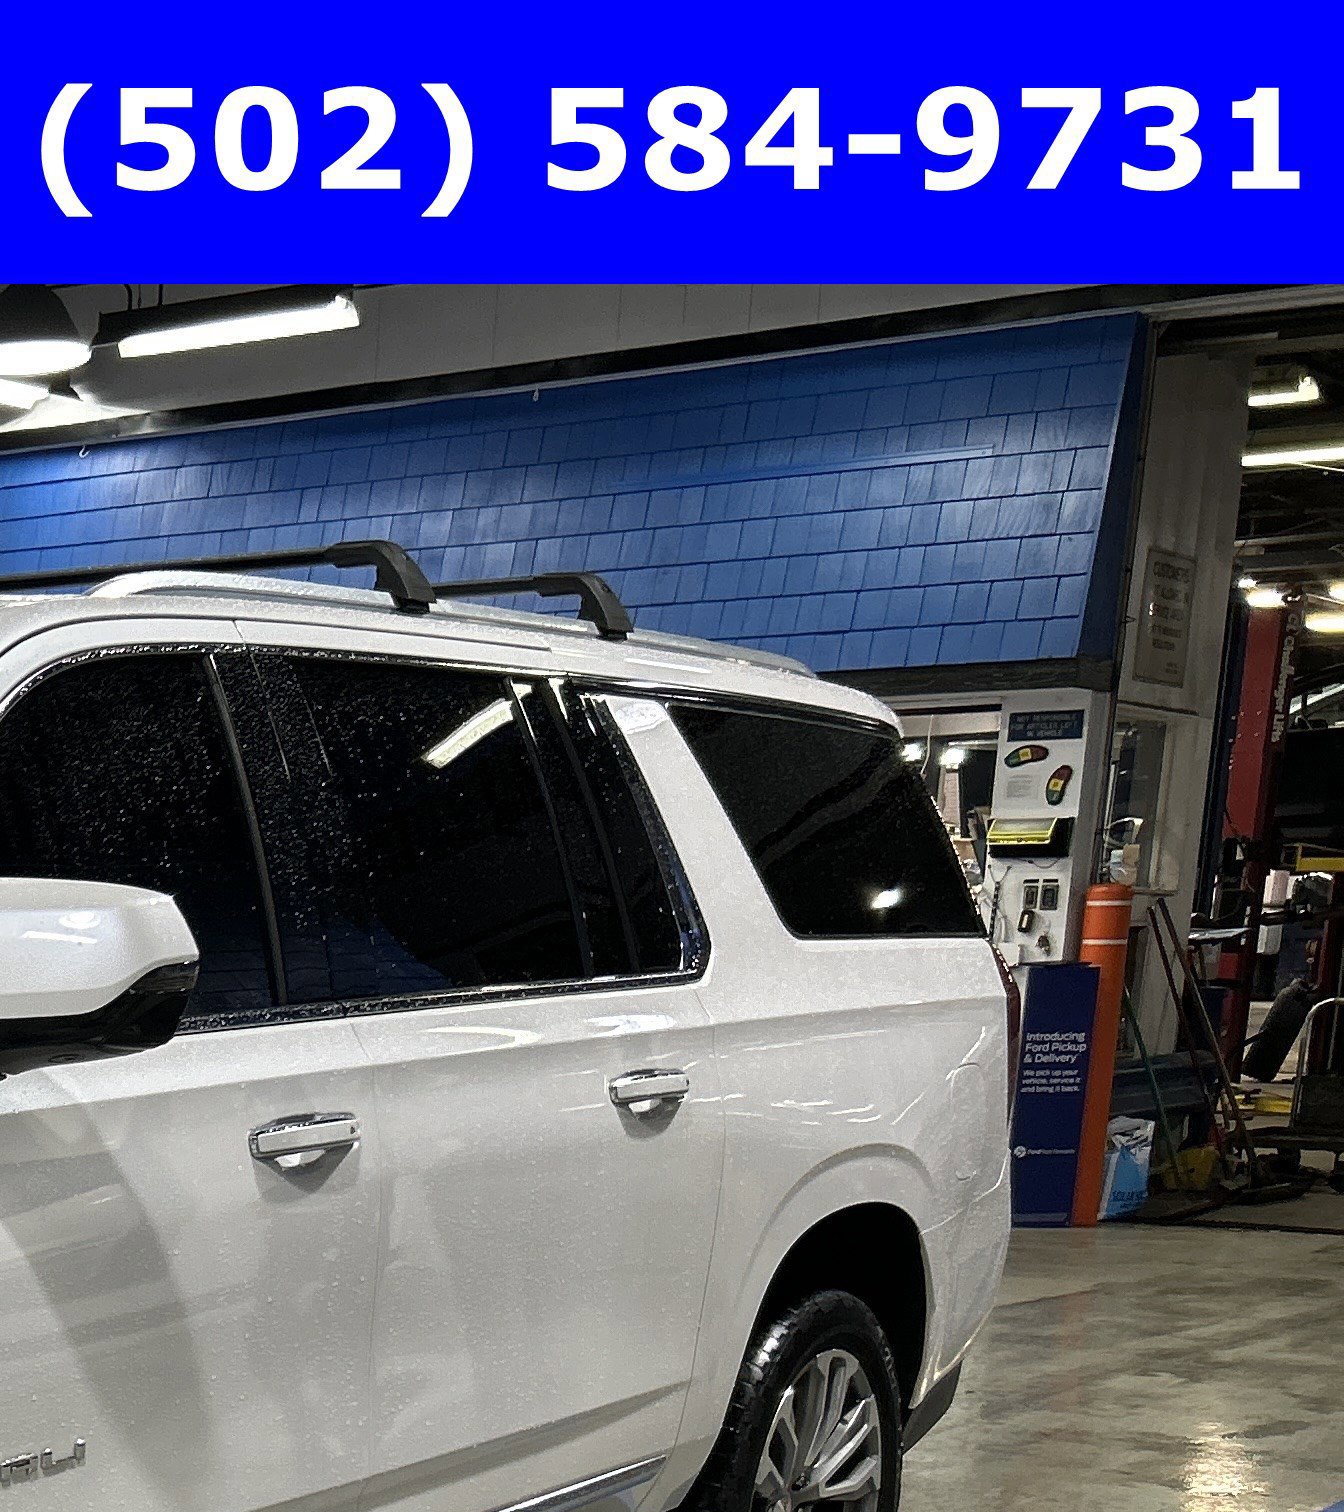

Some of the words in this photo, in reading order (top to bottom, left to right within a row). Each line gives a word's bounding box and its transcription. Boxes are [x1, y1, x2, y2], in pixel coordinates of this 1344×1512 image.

[1026, 1032, 1086, 1042] Introducing
[1025, 1042, 1050, 1052] Ford
[1052, 1042, 1087, 1053] Pickup
[1034, 1053, 1077, 1063] Delivery
